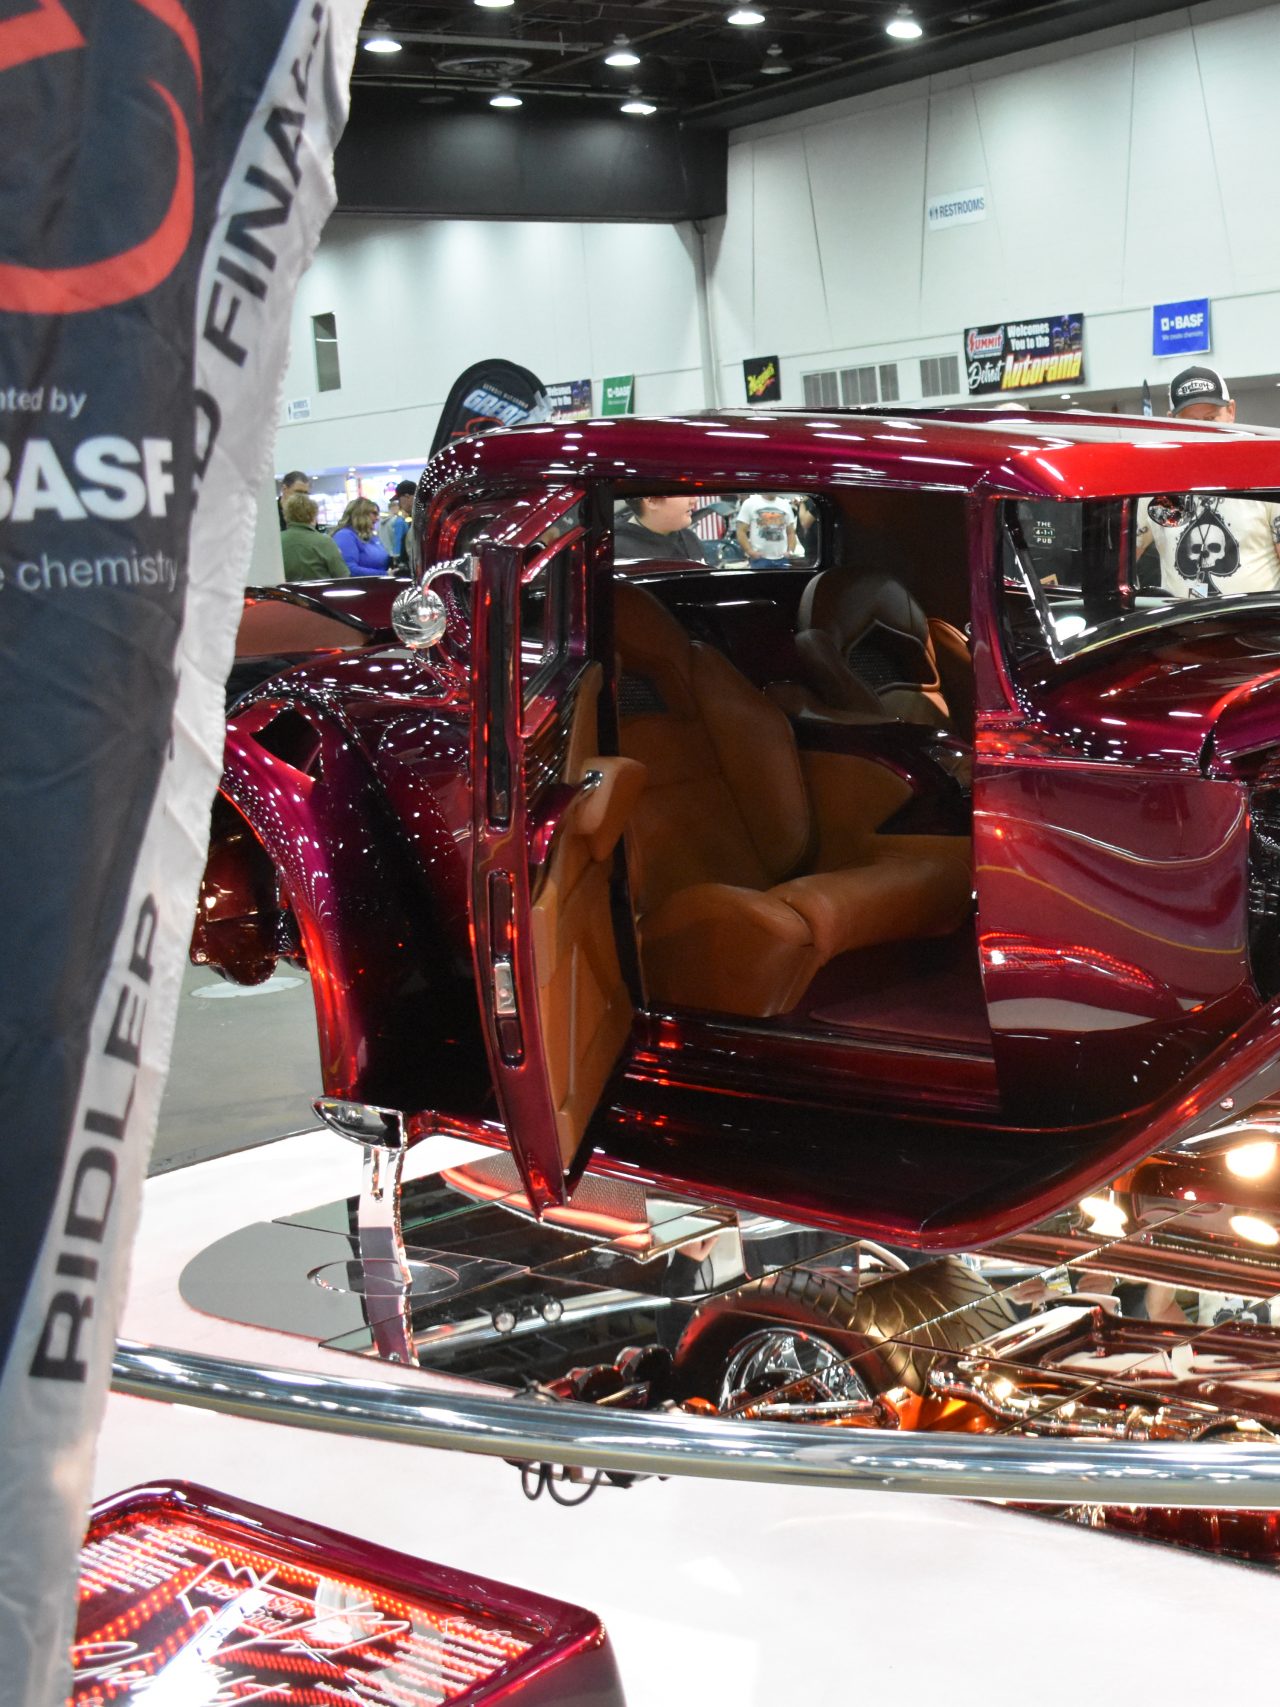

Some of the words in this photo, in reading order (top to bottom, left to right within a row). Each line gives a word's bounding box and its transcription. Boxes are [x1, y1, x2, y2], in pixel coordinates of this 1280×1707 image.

[939, 197, 985, 218] RESTROOMS
[1007, 322, 1050, 338] Welcomes
[1174, 312, 1204, 330] BASF
[967, 329, 1003, 353] SUMMIT
[1011, 338, 1025, 351] You
[1027, 337, 1035, 349] to
[1036, 335, 1050, 348] the
[1002, 350, 1082, 390] Autorama
[50, 385, 88, 419] by
[463, 389, 530, 426] GREAT
[0, 435, 176, 522] ASF
[17, 548, 177, 592] chemistry
